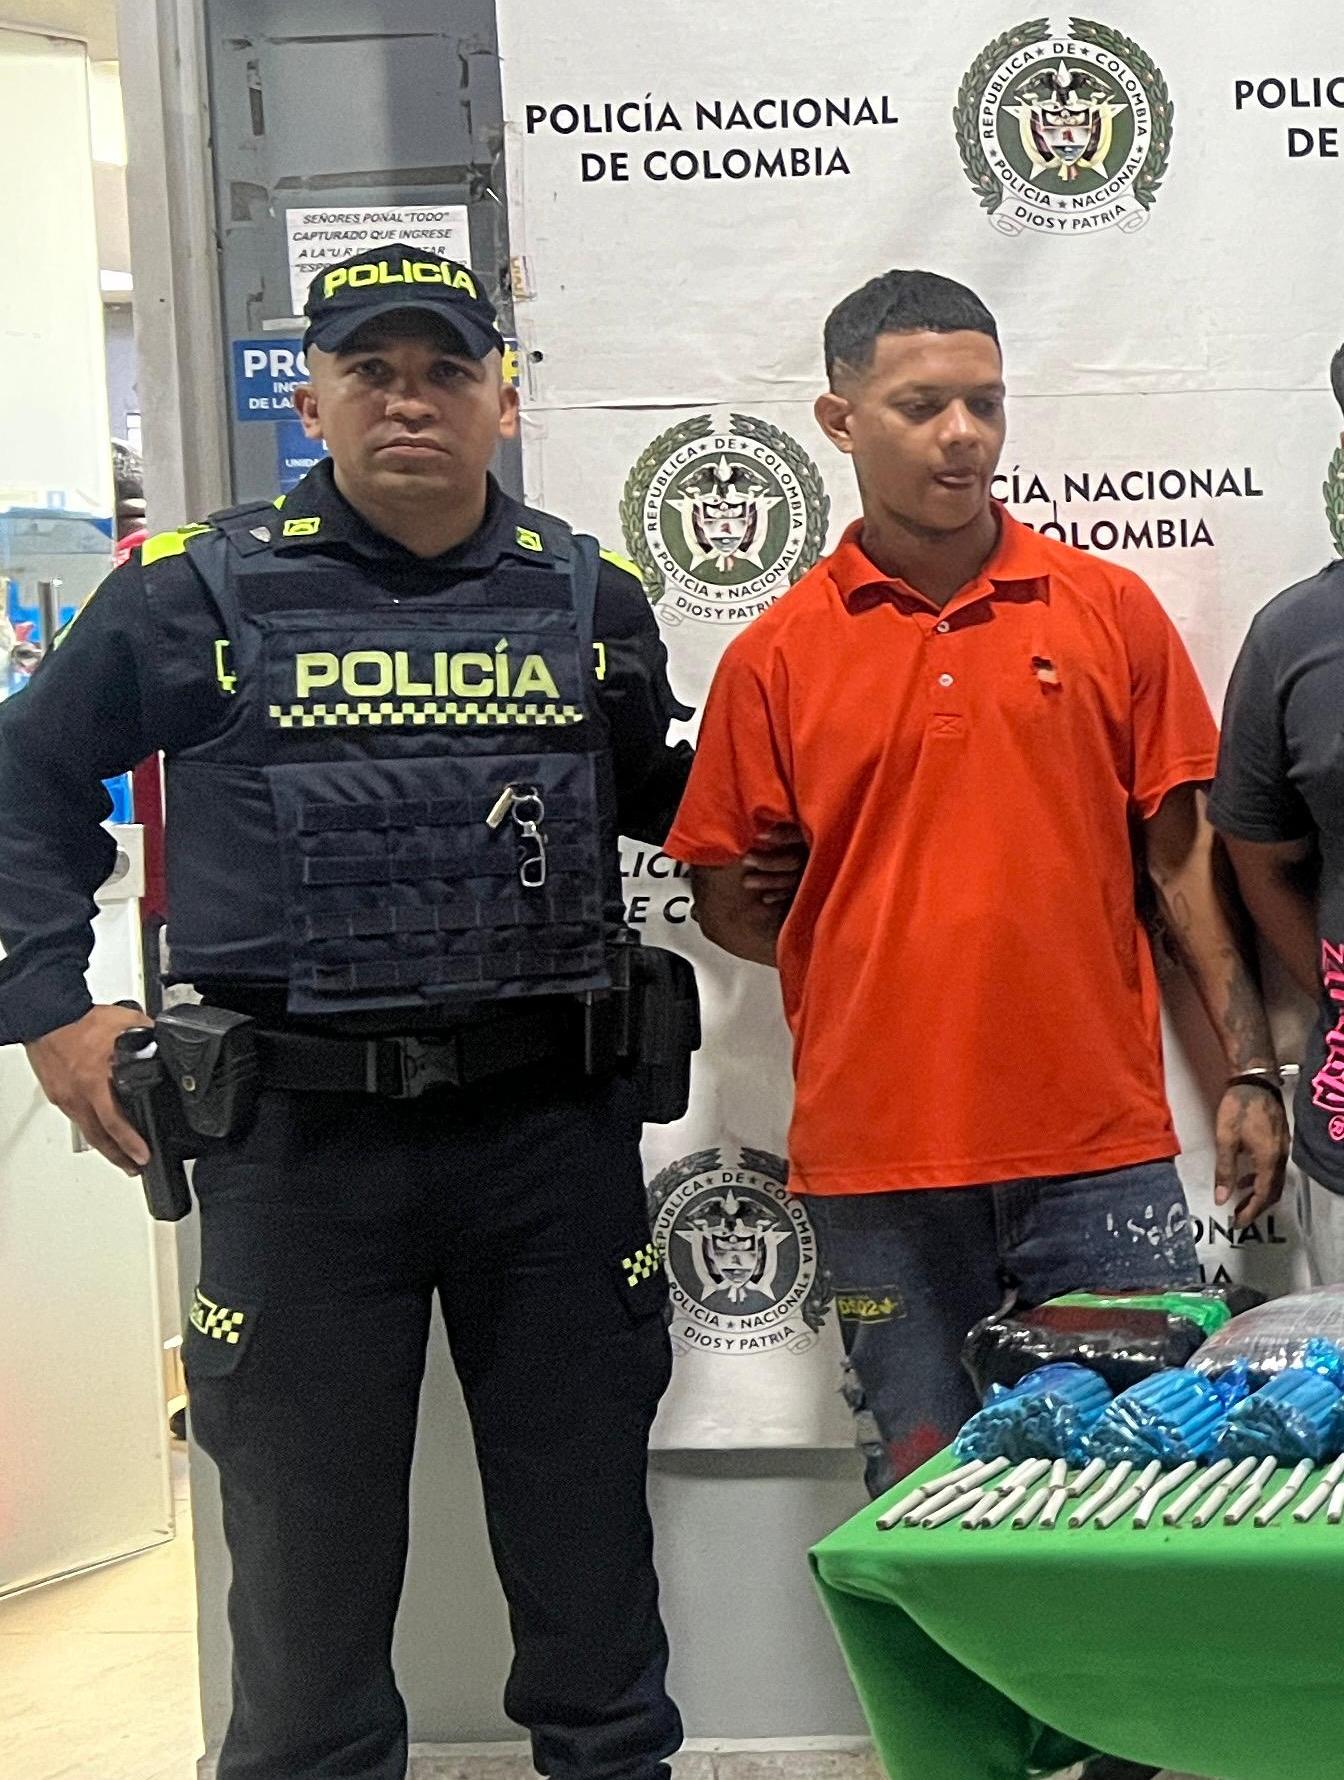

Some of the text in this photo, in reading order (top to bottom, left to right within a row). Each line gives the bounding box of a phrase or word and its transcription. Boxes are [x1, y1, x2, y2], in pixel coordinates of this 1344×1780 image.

[983, 43, 1148, 139] REPUBLICA DE COLOMBIA
[525, 92, 899, 134] POLICÍA NACIONAL
[1287, 127, 1339, 158] DE
[581, 147, 851, 182] DE COLOMBIA
[994, 156, 1142, 209] POLICIA NACIONAL
[1015, 204, 1126, 230] DIOS Y PATRIA
[293, 229, 452, 241] CAPTURADO QUE INGRESE
[249, 397, 269, 410] DE
[648, 438, 803, 531] REPUBLICA DE COLOMBIA
[1065, 467, 1264, 502] NACIONAL
[1023, 517, 1215, 551] OLOMBIA
[656, 548, 798, 599] POLICIA NACIONAL
[676, 596, 712, 618] DIOS
[714, 609, 724, 619] Y
[295, 637, 561, 698] POLICÍA
[722, 1172, 745, 1184] DE
[763, 1181, 813, 1264] COLOMBIA
[669, 1281, 810, 1330] POLICIA NACIONAL
[684, 1326, 795, 1350] DIOS Y PATRIA
